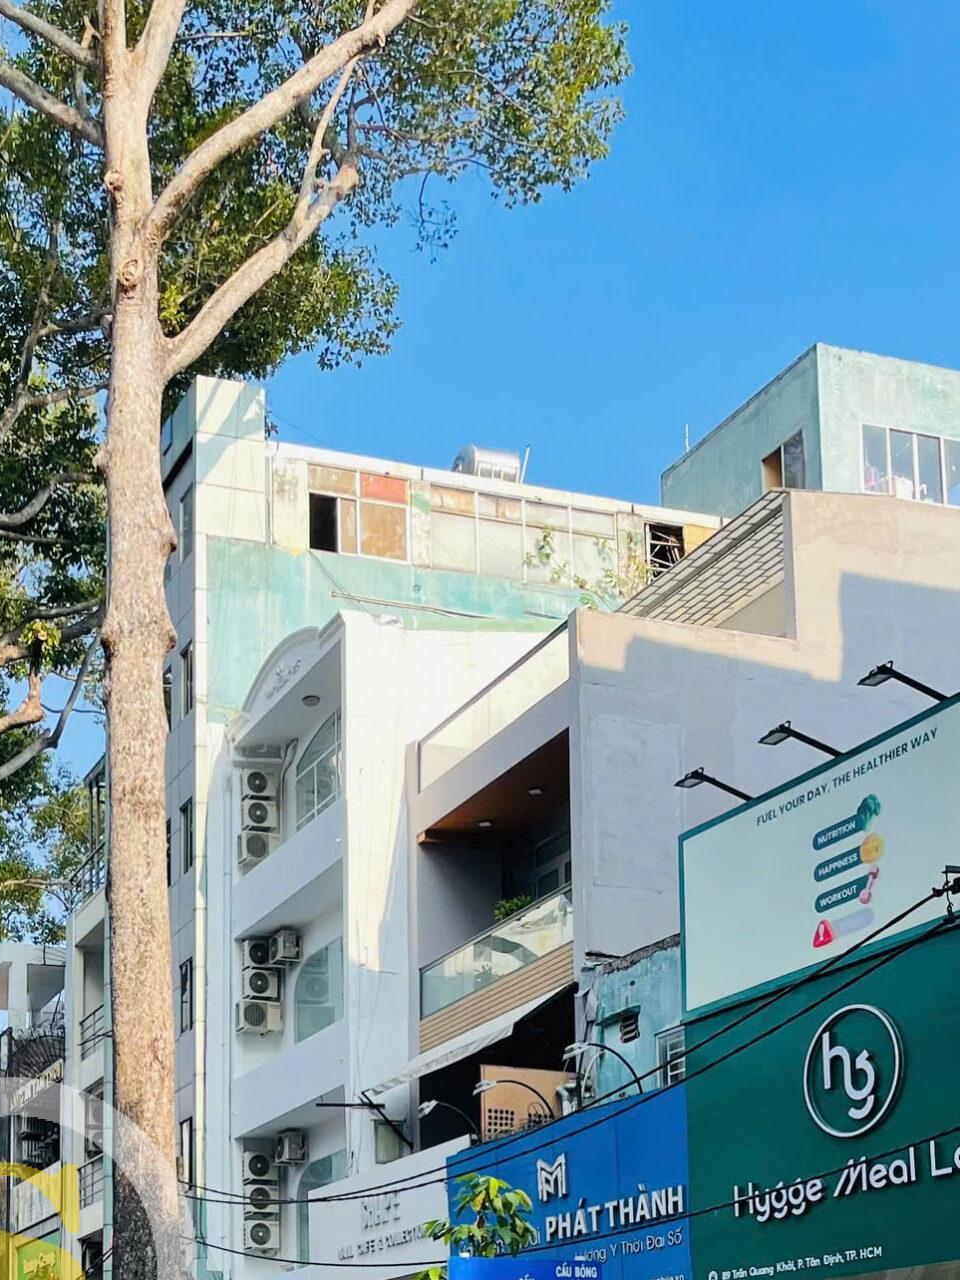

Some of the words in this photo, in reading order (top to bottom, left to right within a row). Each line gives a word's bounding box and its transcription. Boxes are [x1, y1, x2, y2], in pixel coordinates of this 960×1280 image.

[756, 809, 777, 826] FUEL
[779, 794, 806, 815] YOUR
[832, 771, 851, 788] THE
[852, 743, 909, 779] HEALTHIER
[910, 727, 938, 750] WAY
[817, 820, 856, 845] NUTRITION
[818, 853, 858, 876] HAPPINESS
[820, 885, 858, 907] WORKOUT
[734, 1178, 823, 1222] Hygge
[833, 1147, 916, 1197] Meal
[545, 1198, 600, 1241] PHÁT
[604, 1183, 683, 1228] THÀNH
[610, 1243, 618, 1258] Y
[621, 1238, 643, 1255] Thời
[646, 1235, 665, 1251] Đại
[668, 1227, 684, 1246] Số
[749, 1266, 774, 1276] Quang
[860, 1246, 882, 1259] HCM
